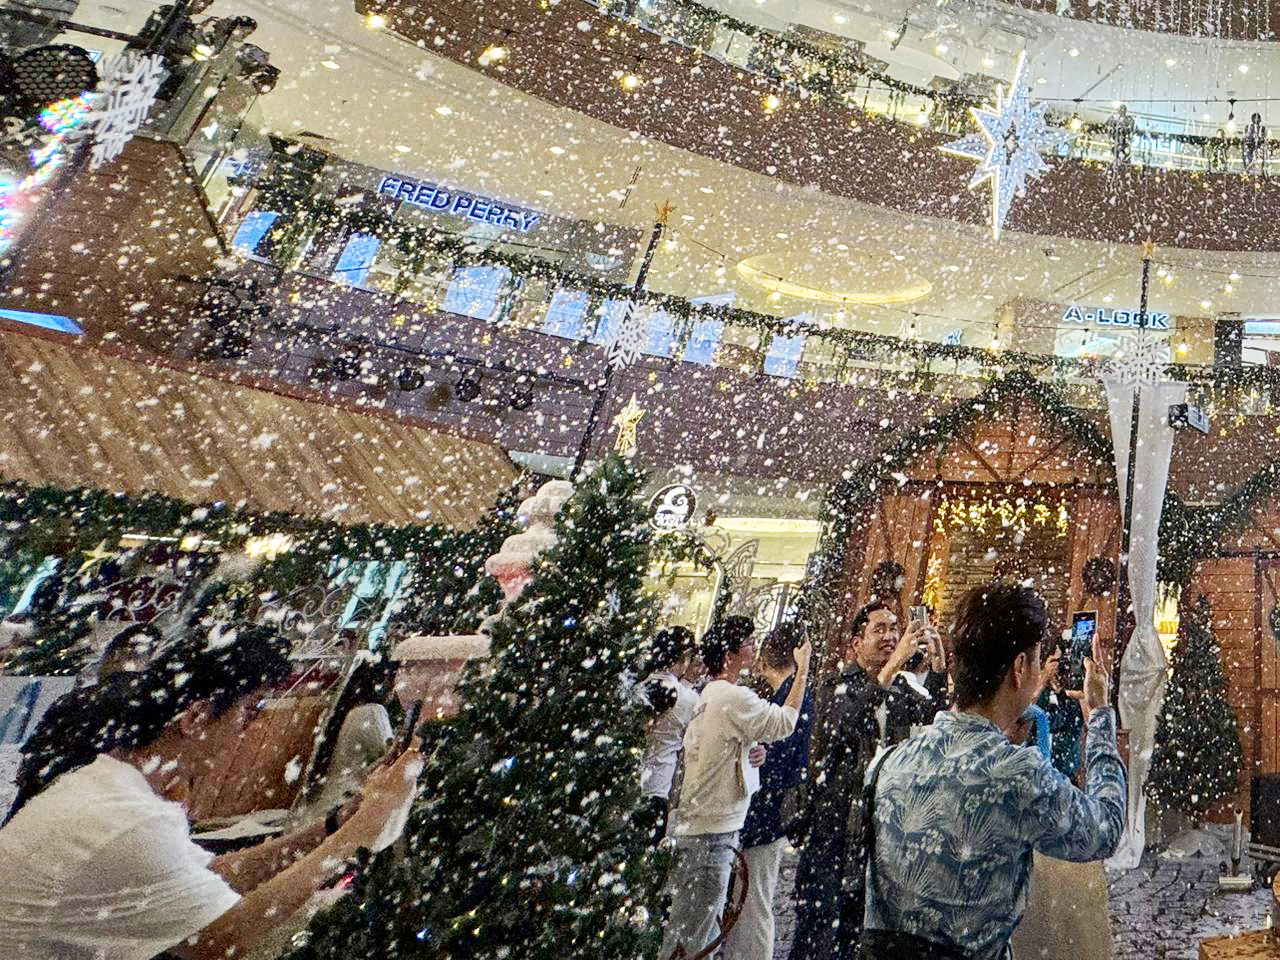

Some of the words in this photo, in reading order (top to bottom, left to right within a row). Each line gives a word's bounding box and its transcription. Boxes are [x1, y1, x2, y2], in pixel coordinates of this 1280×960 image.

[377, 176, 451, 212] FRED
[449, 195, 541, 234] PERRY
[1062, 305, 1170, 330] A-LOOK
